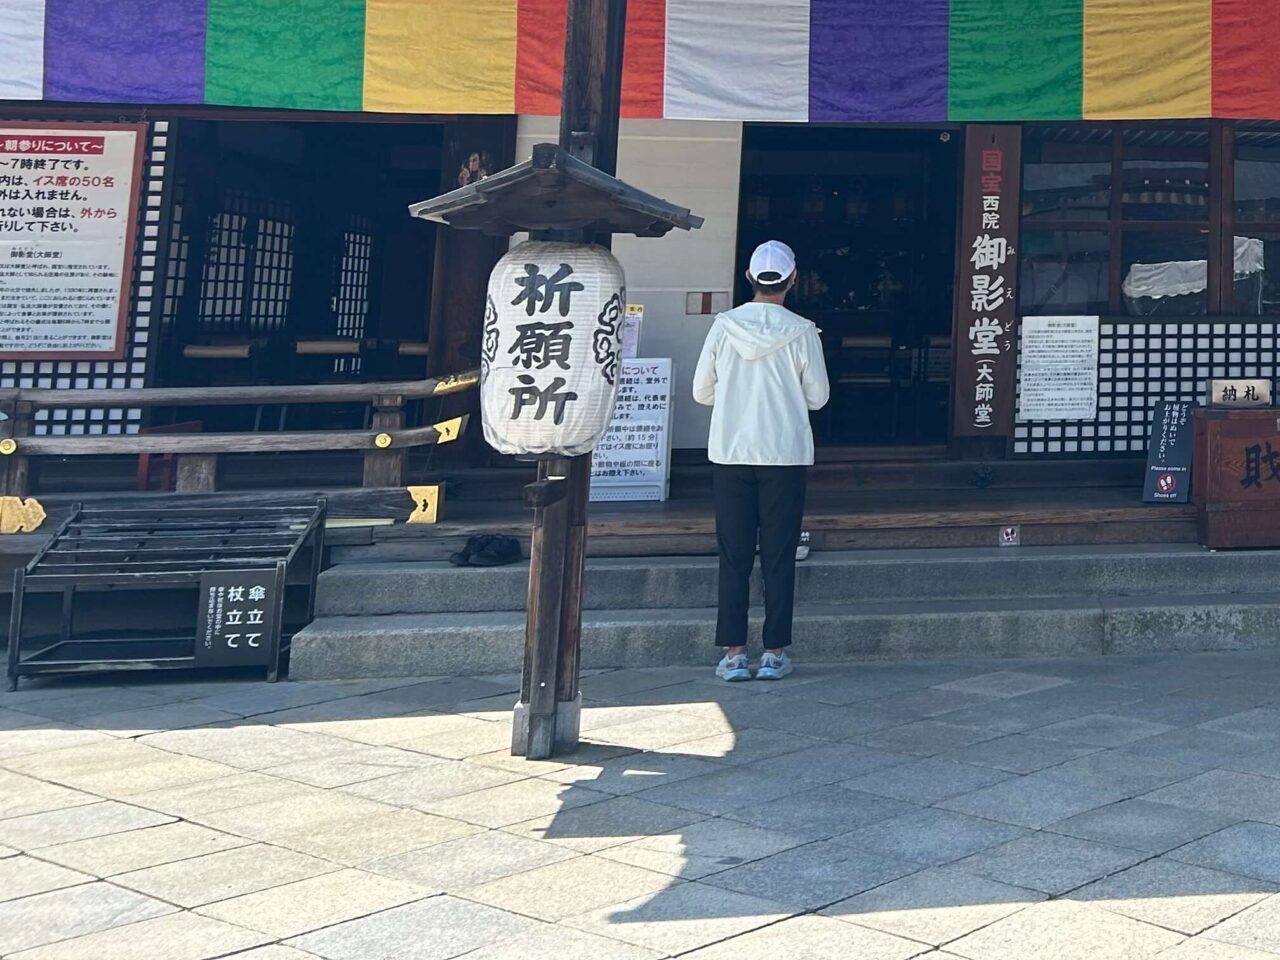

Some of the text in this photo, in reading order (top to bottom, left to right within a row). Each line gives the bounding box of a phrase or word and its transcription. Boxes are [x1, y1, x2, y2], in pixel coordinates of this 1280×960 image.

[0, 139, 104, 152] 朝参りについて～
[0, 221, 79, 233] りして下さい。
[982, 195, 1000, 229] 西院
[969, 233, 1008, 355] 御影堂
[508, 263, 584, 426] 祈願所
[973, 359, 996, 428] (大師堂)
[1221, 385, 1260, 401] 納札
[224, 585, 245, 648] 杖立て
[245, 585, 266, 647] 傘立て
